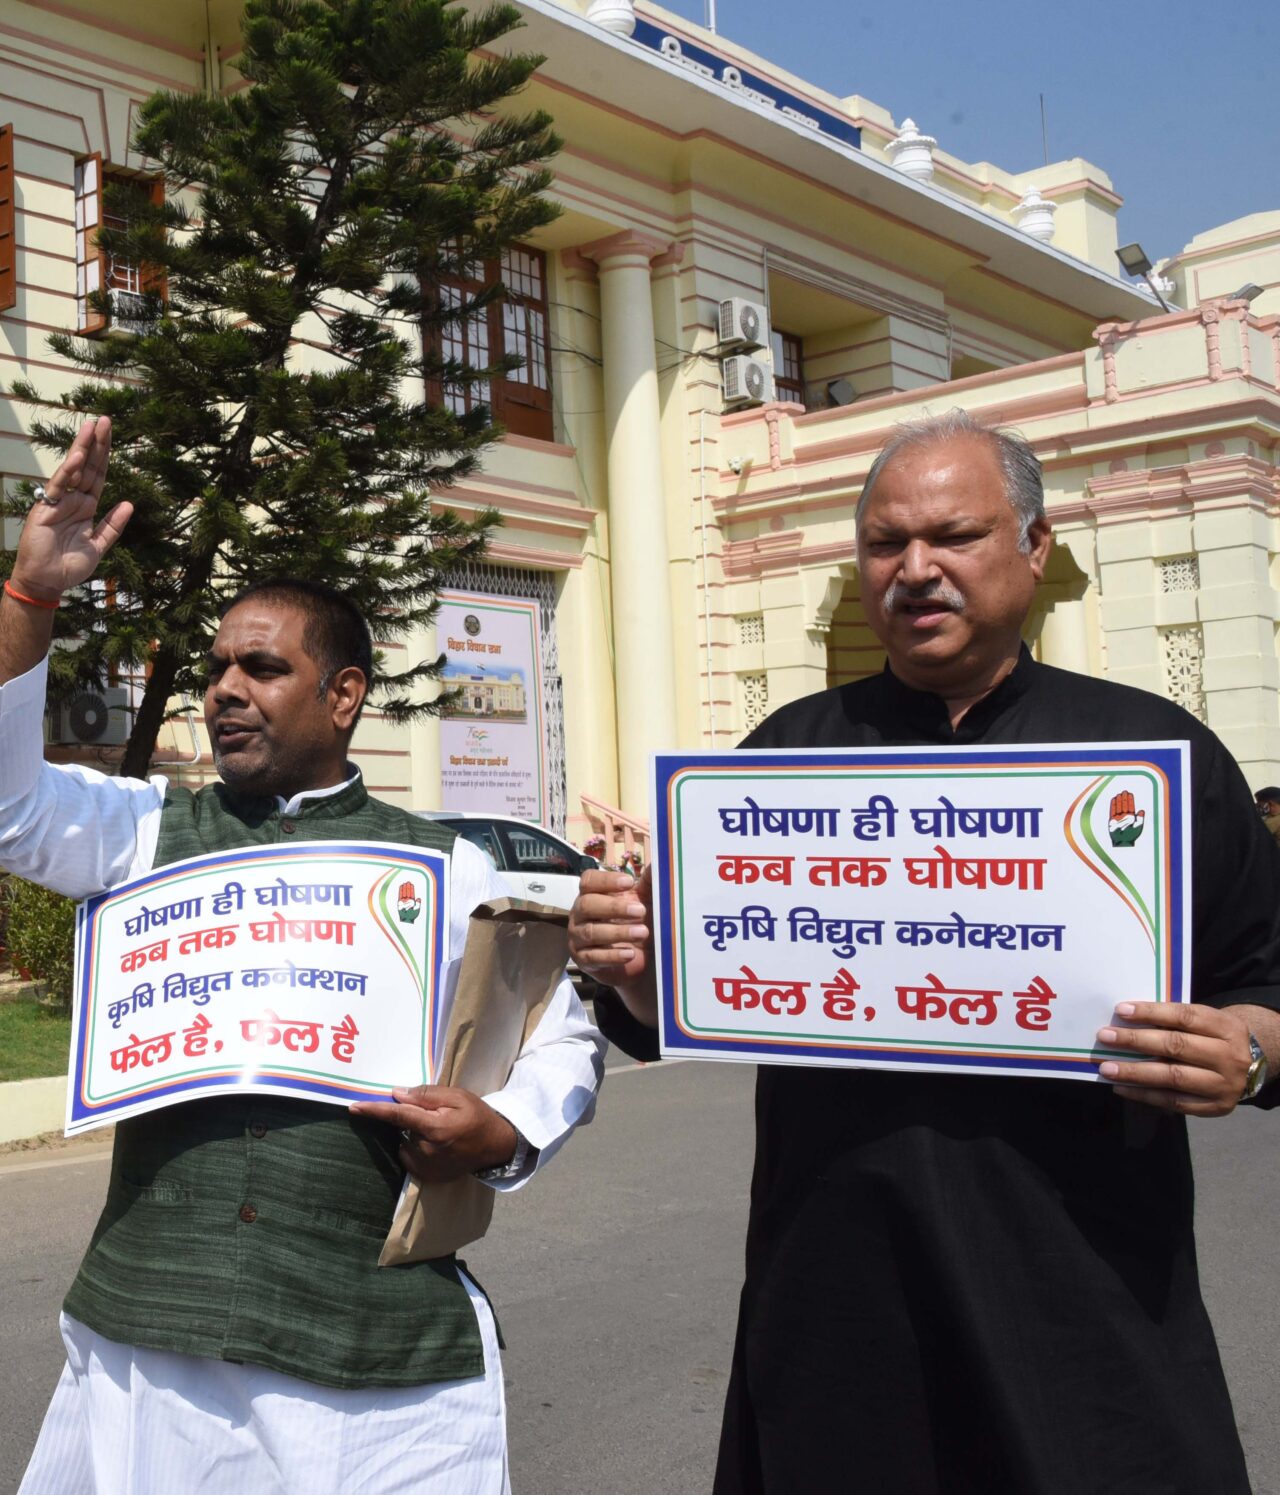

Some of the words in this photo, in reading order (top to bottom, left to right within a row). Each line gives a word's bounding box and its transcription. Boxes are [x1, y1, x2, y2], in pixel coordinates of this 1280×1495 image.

[719, 797, 840, 836] घोषणा
[852, 795, 898, 840] ही
[911, 796, 1042, 837] घोषणा
[717, 856, 795, 885] कब
[807, 857, 891, 887] तक
[903, 845, 1047, 890] घोषणा
[124, 896, 203, 937] घोषणा
[213, 882, 243, 914] ही
[256, 880, 350, 905] घोषणा
[704, 906, 777, 951] कृषि
[788, 907, 884, 959] विद्युत
[895, 912, 1065, 951] कनेक्शन
[121, 940, 169, 972] कब
[179, 926, 239, 954] तक
[250, 912, 355, 944] घोषणा
[109, 983, 153, 1028] कृषि
[164, 973, 230, 1005] विद्युत
[241, 959, 368, 997] कनेक्शन
[713, 966, 810, 1015] फेल
[821, 968, 876, 1021] है,
[896, 973, 1002, 1025] फेल
[1013, 976, 1056, 1031] है
[111, 1032, 175, 1072] फेल
[183, 1014, 223, 1056] है,
[240, 1008, 323, 1054] फेल
[332, 1015, 359, 1062] है
